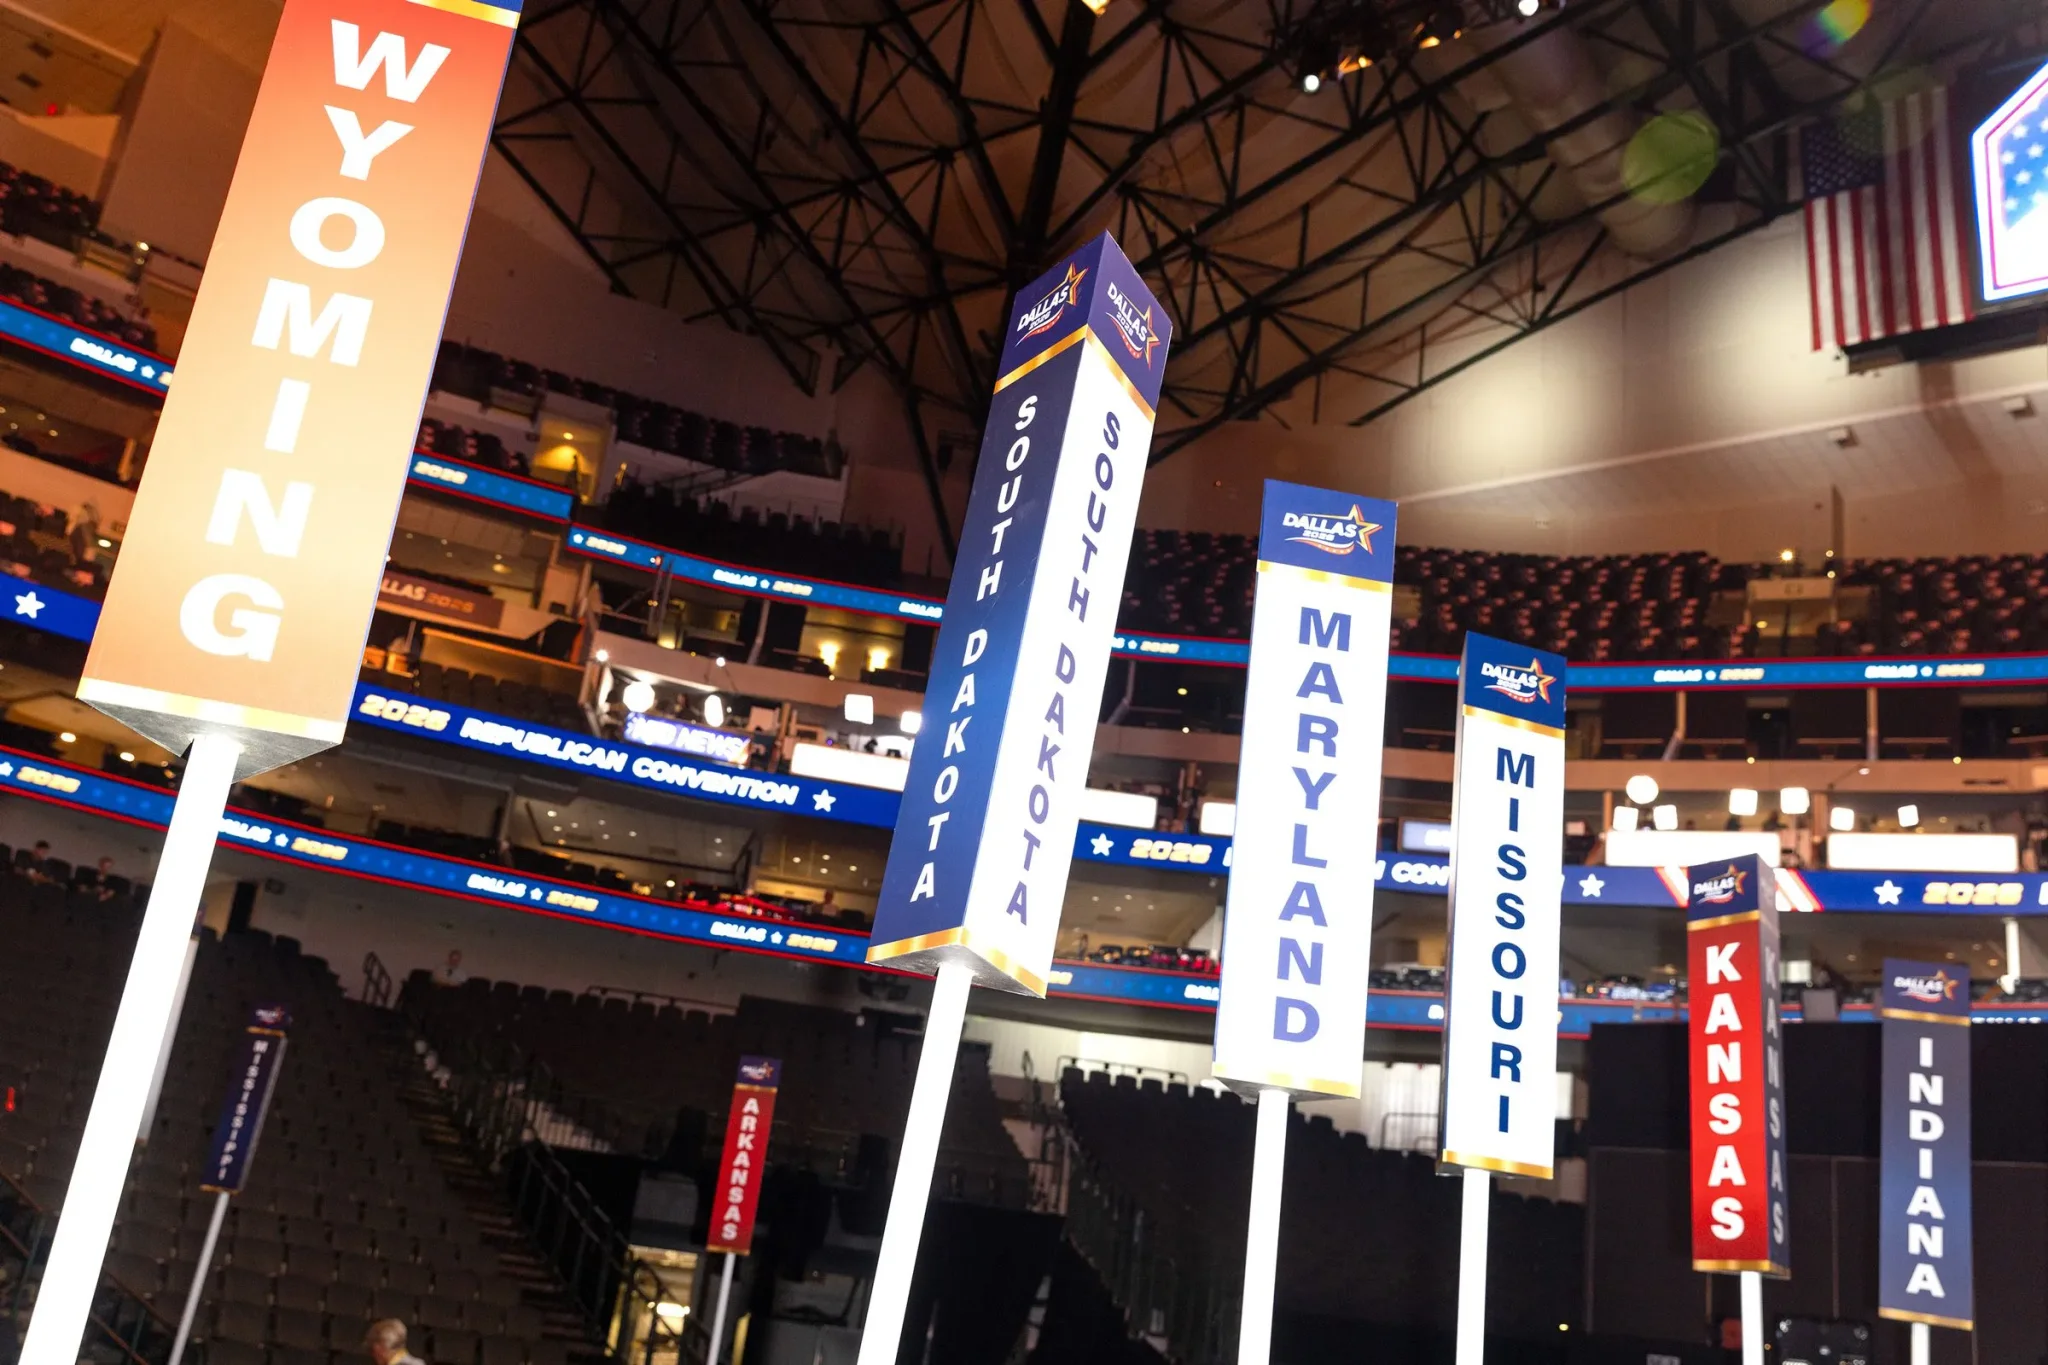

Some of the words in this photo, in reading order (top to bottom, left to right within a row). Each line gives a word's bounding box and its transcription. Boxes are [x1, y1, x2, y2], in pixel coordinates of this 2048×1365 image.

[70, 337, 138, 373] DALLAS
[180, 19, 451, 662] WYOMING
[1017, 284, 1070, 332] DALLAS
[1106, 281, 1148, 342] DALLAS
[976, 395, 1038, 601] SOUTH
[1067, 411, 1121, 623] SOUTH
[1282, 511, 1358, 538] DALLAS
[379, 577, 427, 602] LLAS
[1481, 662, 1538, 689] DALLAS
[459, 717, 628, 773] REPUBLICAN
[631, 756, 799, 806] CONVENTION
[910, 628, 988, 903] DAKOTA
[1006, 642, 1076, 926] DAKOTA
[1273, 606, 1352, 1044] MARYLAND
[467, 873, 526, 898] DALLAS
[710, 921, 767, 943] DALLAS
[1490, 746, 1535, 1133] MISSOURI
[1693, 876, 1735, 896] DALLAS
[1894, 976, 1944, 992] DALLAS
[217, 1040, 269, 1181] MISSISSIPPI
[1704, 941, 1747, 1241] KANSAS
[1764, 946, 1784, 1245] KANSAS
[721, 1097, 760, 1241] ARKANSAS
[1905, 1037, 1946, 1299] INDIANA
